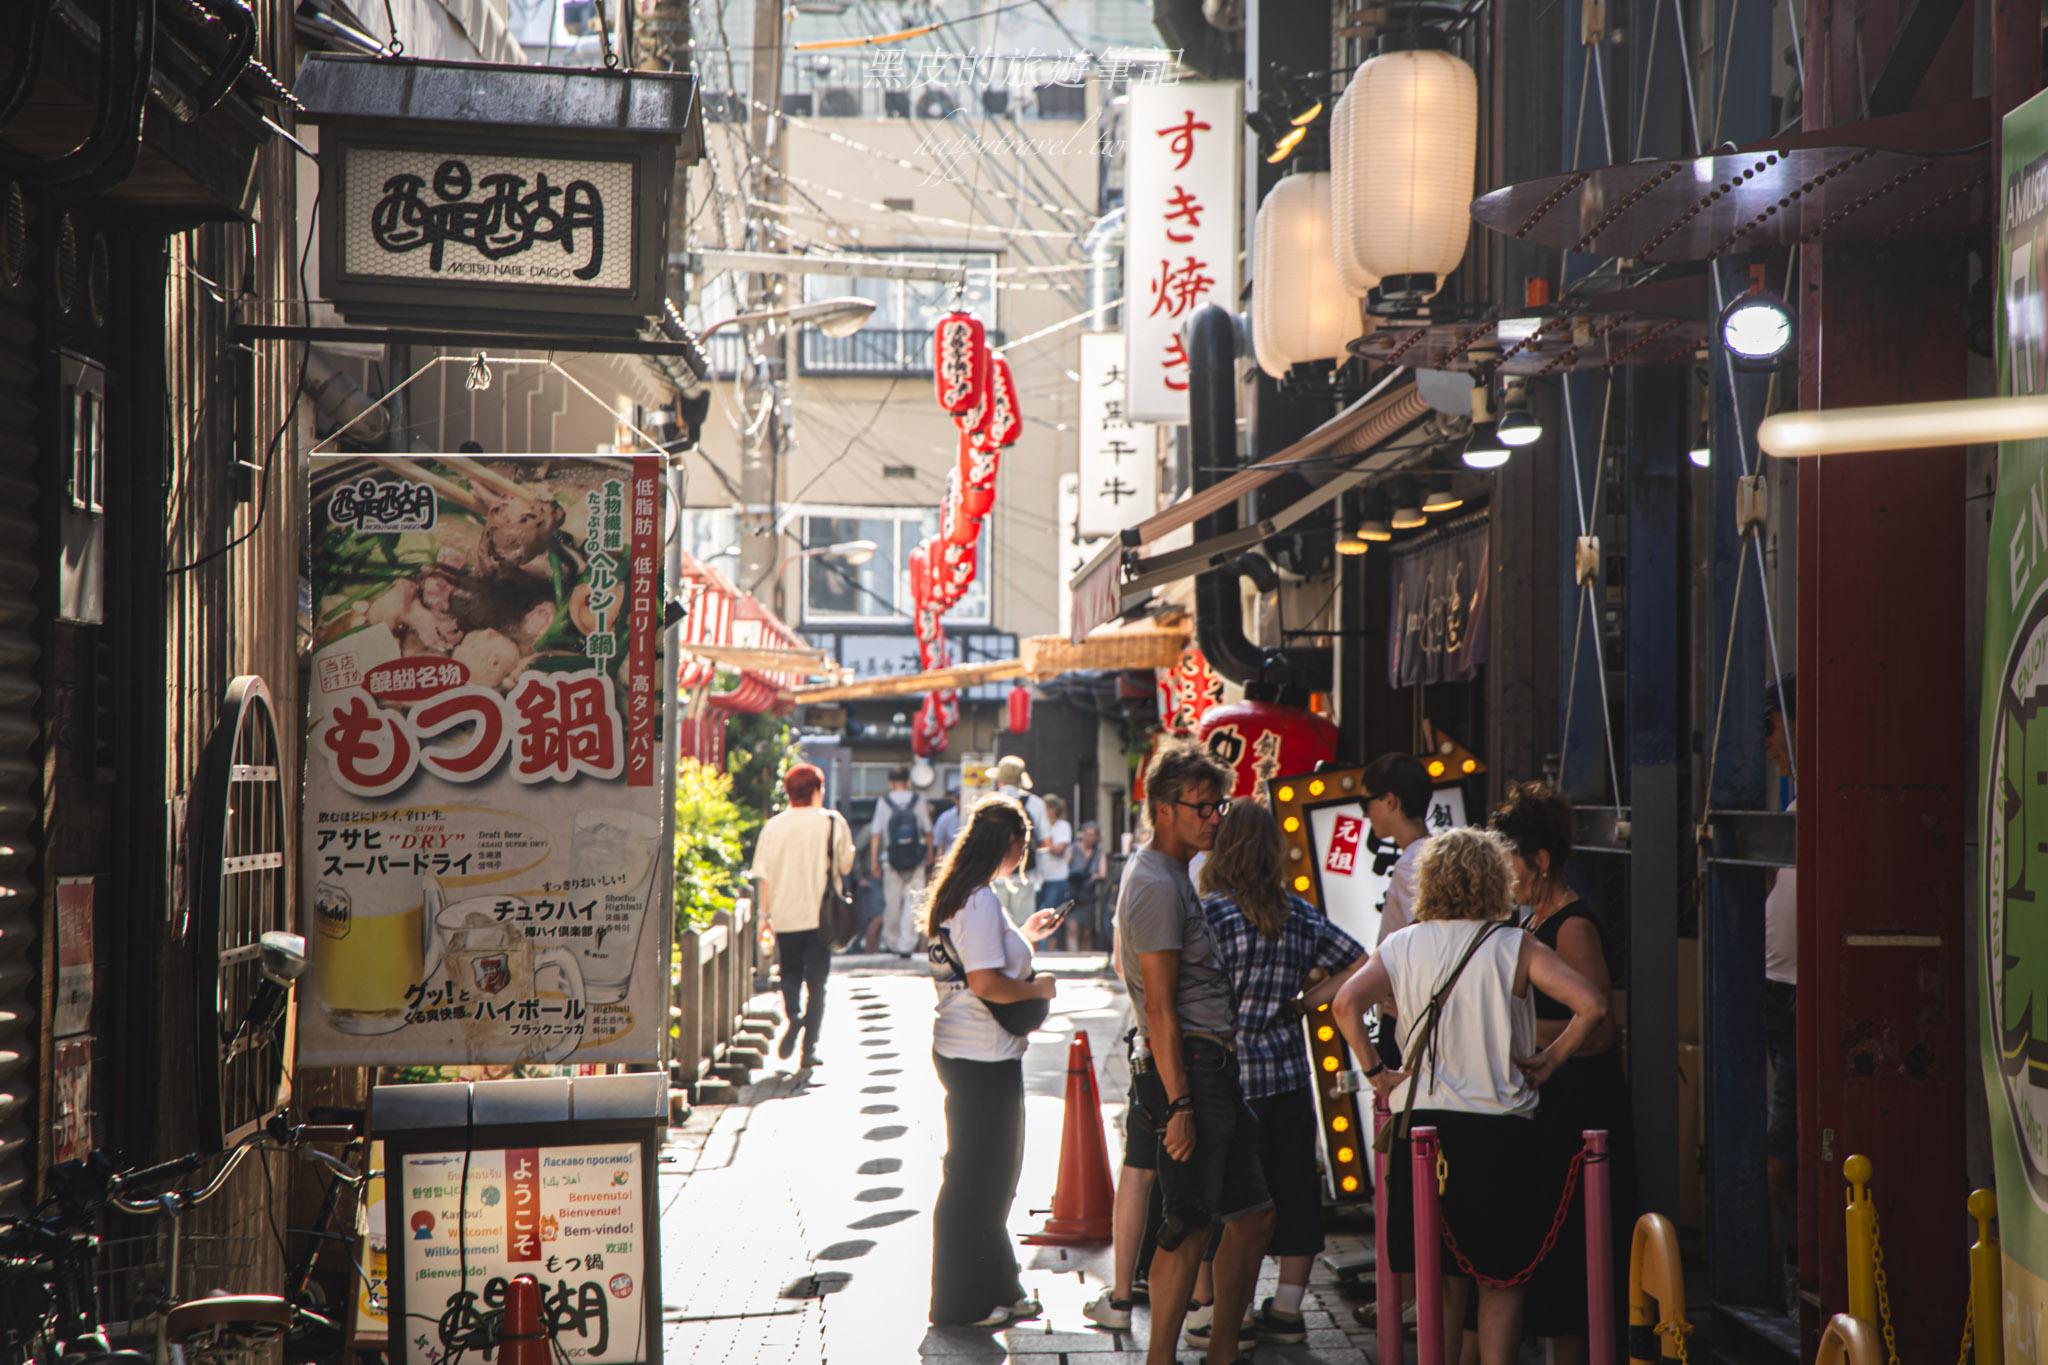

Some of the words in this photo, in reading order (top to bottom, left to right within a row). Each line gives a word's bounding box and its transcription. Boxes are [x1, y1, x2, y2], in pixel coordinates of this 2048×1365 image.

[1150, 110, 1216, 392] すき焼き
[446, 260, 490, 276] MOTSU
[493, 264, 524, 277] NABE
[529, 266, 573, 280] DAIGO
[586, 492, 600, 552] たっぷりの
[322, 671, 362, 690] おすすめ
[369, 662, 462, 694] 醍醐名物
[324, 678, 615, 788] もつ鍋
[317, 828, 382, 851] アサヒ
[478, 831, 501, 839] Draft
[1328, 817, 1359, 872] 元祖
[323, 852, 473, 877] スーパードライ
[493, 899, 598, 922] チュウハイ
[474, 999, 586, 1021] ハイボール
[510, 1024, 585, 1036] ブラックニッカ
[543, 1157, 584, 1168] Ласкаво
[586, 1153, 633, 1168] просимо!
[513, 1158, 534, 1256] ようこそ
[568, 1190, 633, 1203] Benvenuto!
[559, 1206, 622, 1219] Bienvenue!
[564, 1222, 634, 1237] Bem-vindo!
[545, 1253, 605, 1274] もつ鍋
